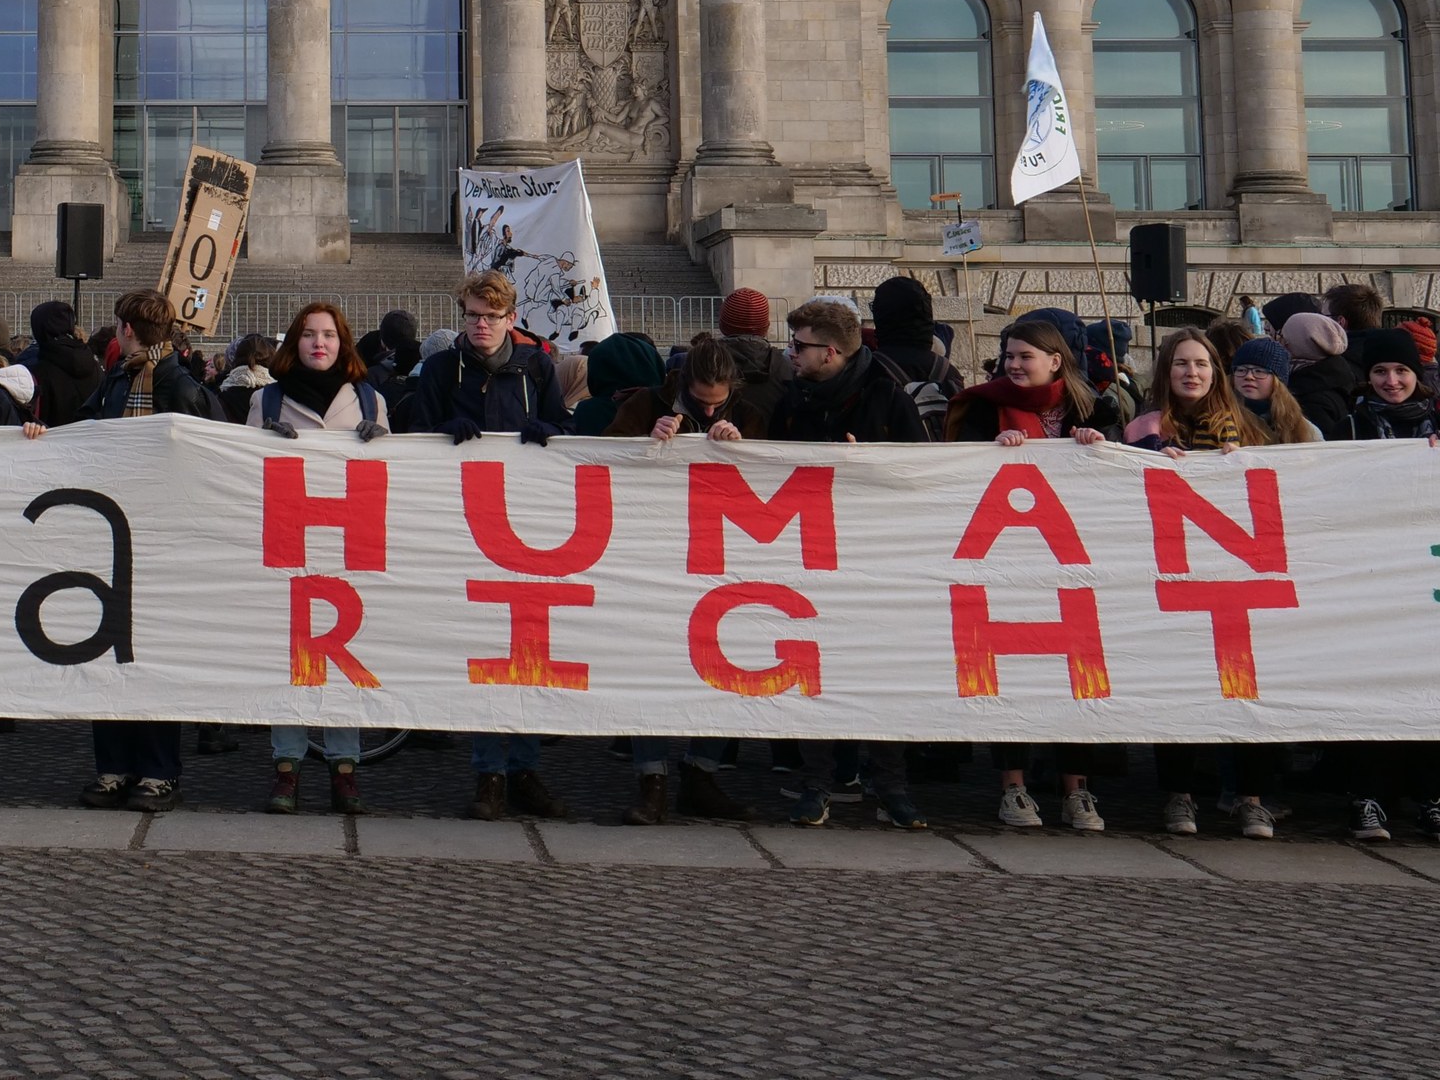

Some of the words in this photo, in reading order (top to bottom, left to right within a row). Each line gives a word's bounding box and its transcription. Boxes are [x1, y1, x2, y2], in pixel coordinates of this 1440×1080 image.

[14, 487, 135, 665] a
[262, 456, 1289, 577] HUMAN
[289, 574, 1301, 700] RIGHT
